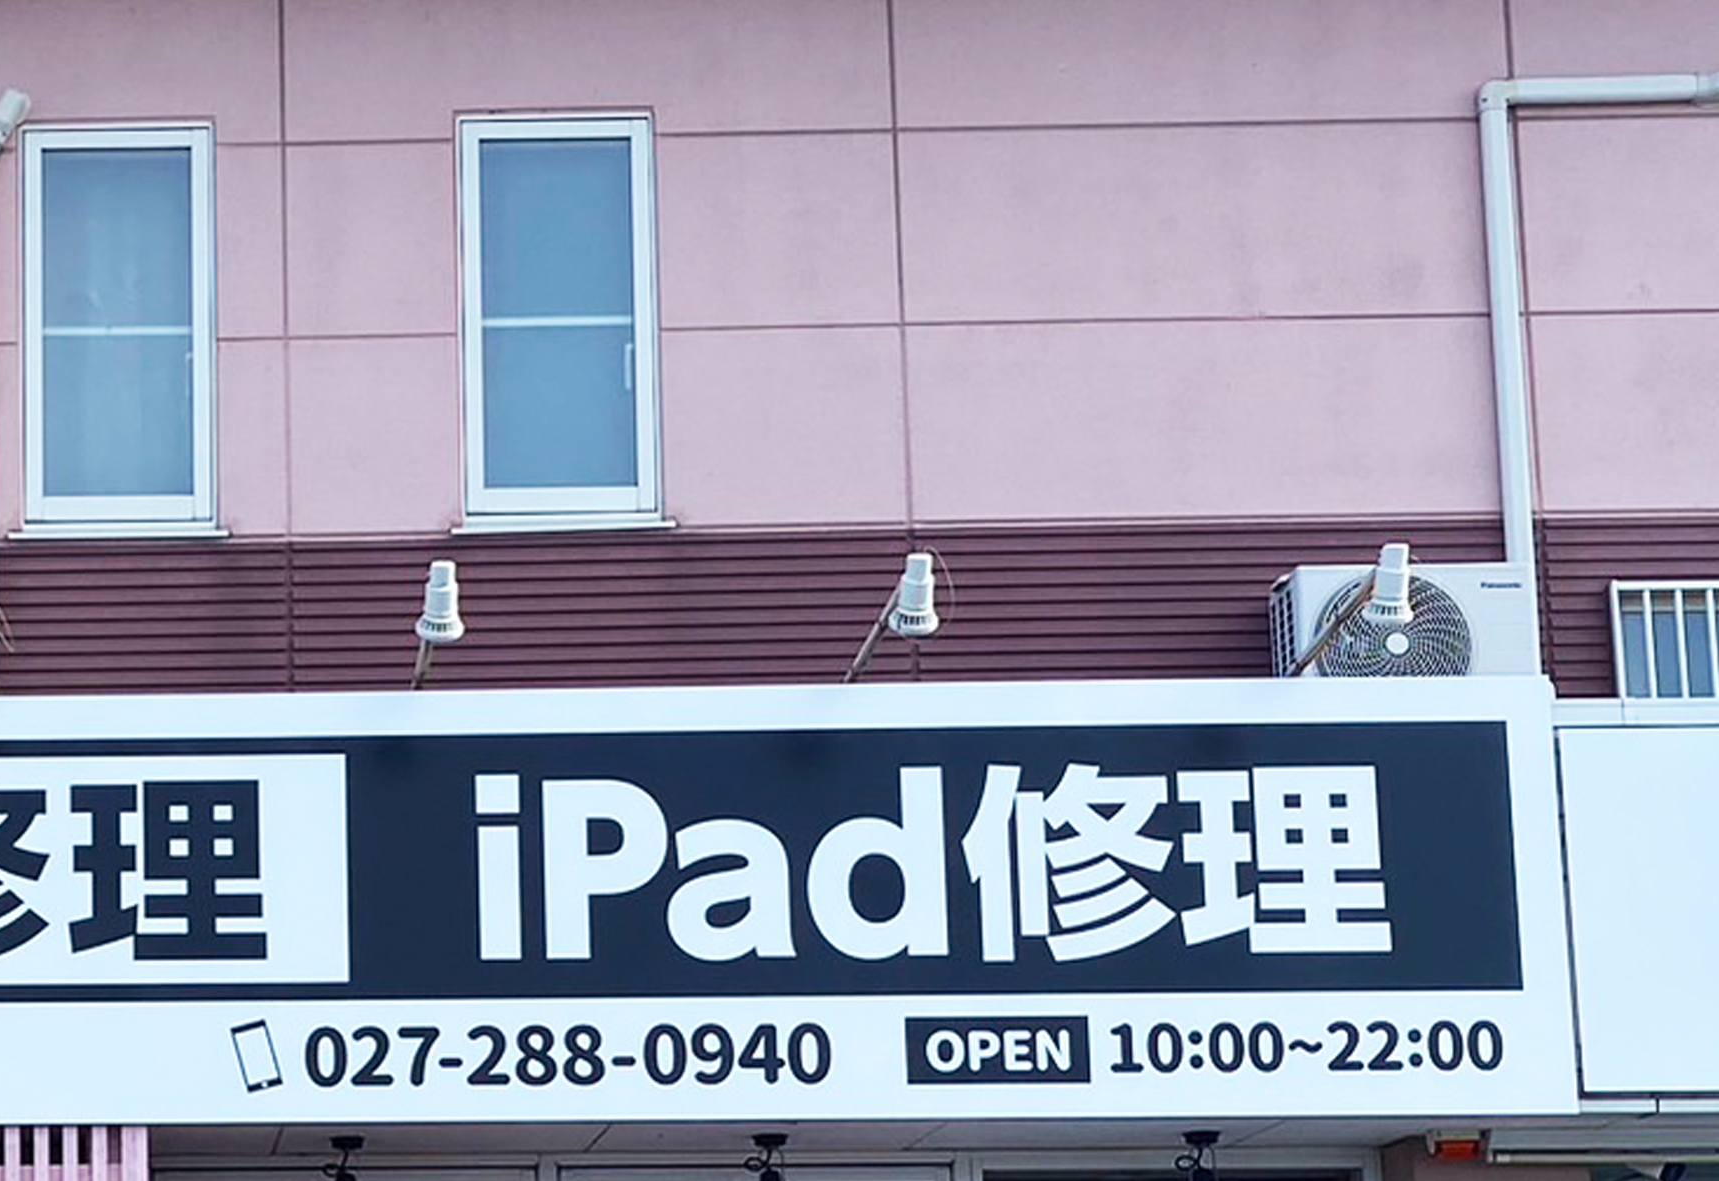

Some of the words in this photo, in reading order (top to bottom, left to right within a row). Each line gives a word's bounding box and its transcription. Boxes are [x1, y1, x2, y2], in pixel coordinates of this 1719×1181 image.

[474, 762, 1393, 963] iPad修理
[305, 1022, 831, 1087] 027-288-0940
[925, 1028, 1072, 1073] OPEN
